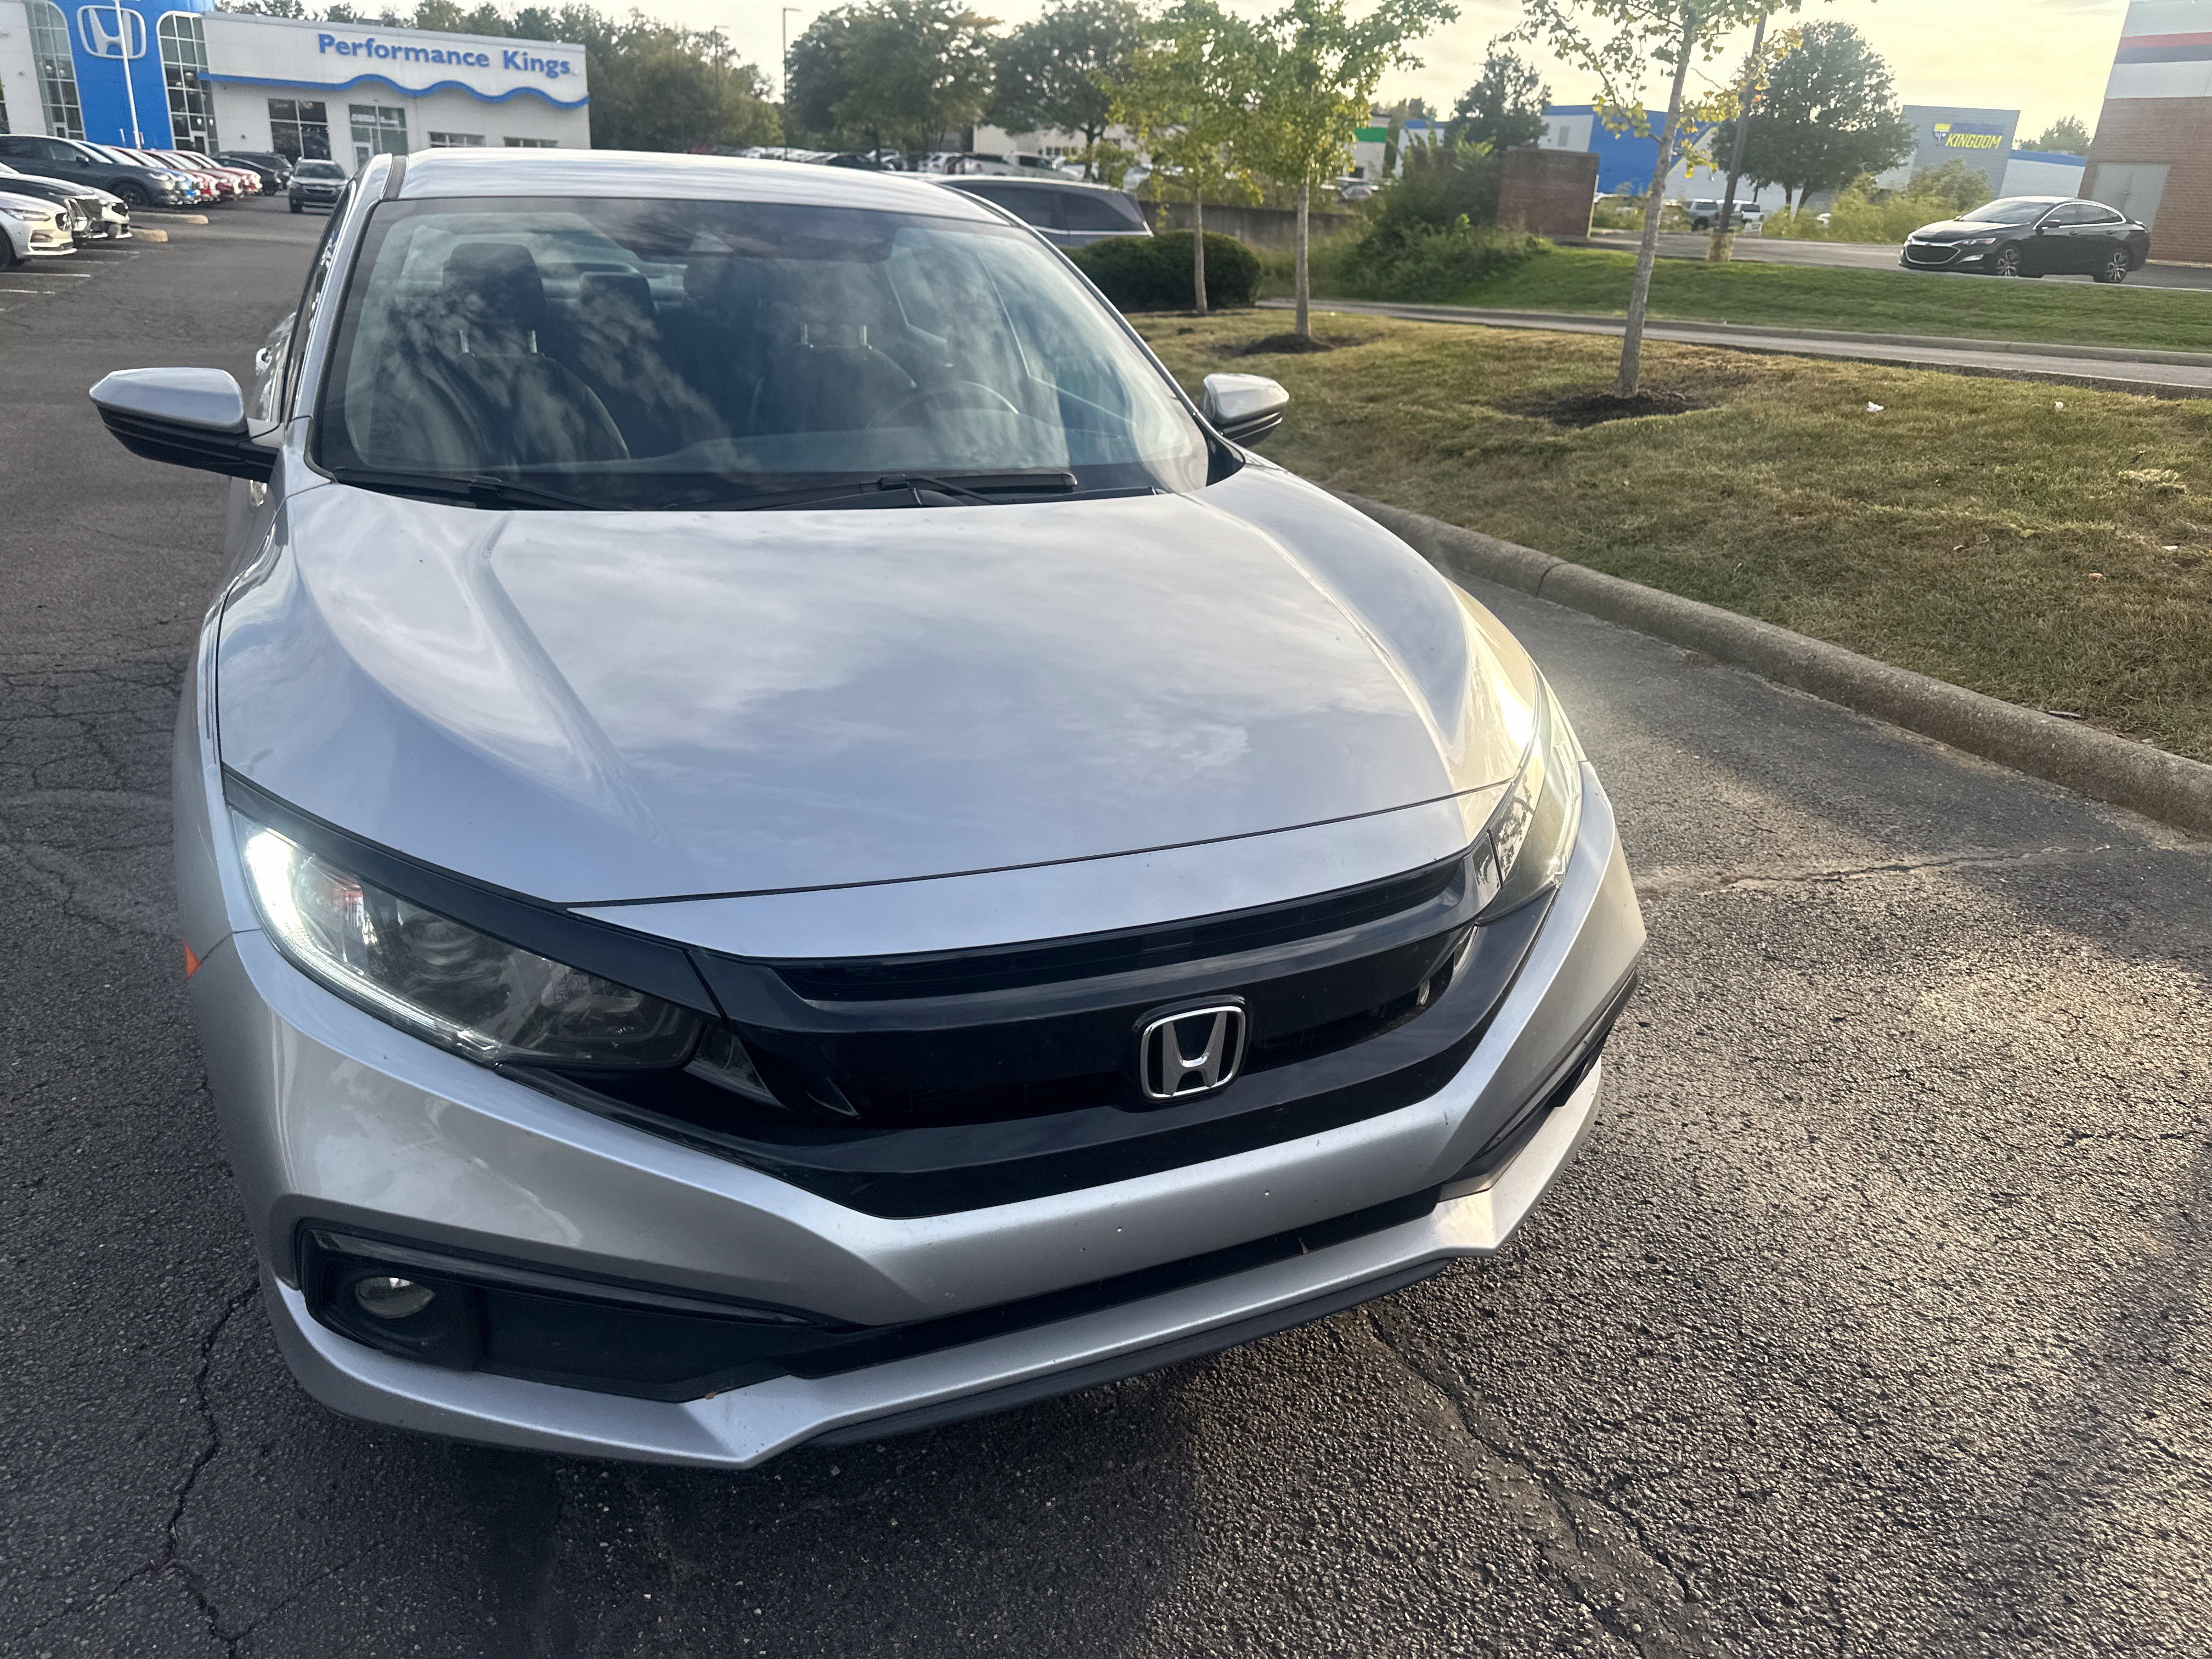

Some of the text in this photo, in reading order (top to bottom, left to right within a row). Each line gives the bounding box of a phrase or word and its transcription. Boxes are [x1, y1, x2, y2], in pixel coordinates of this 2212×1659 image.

[318, 33, 570, 78] Performance Kings
[1945, 133, 2002, 149] KINGDOM
